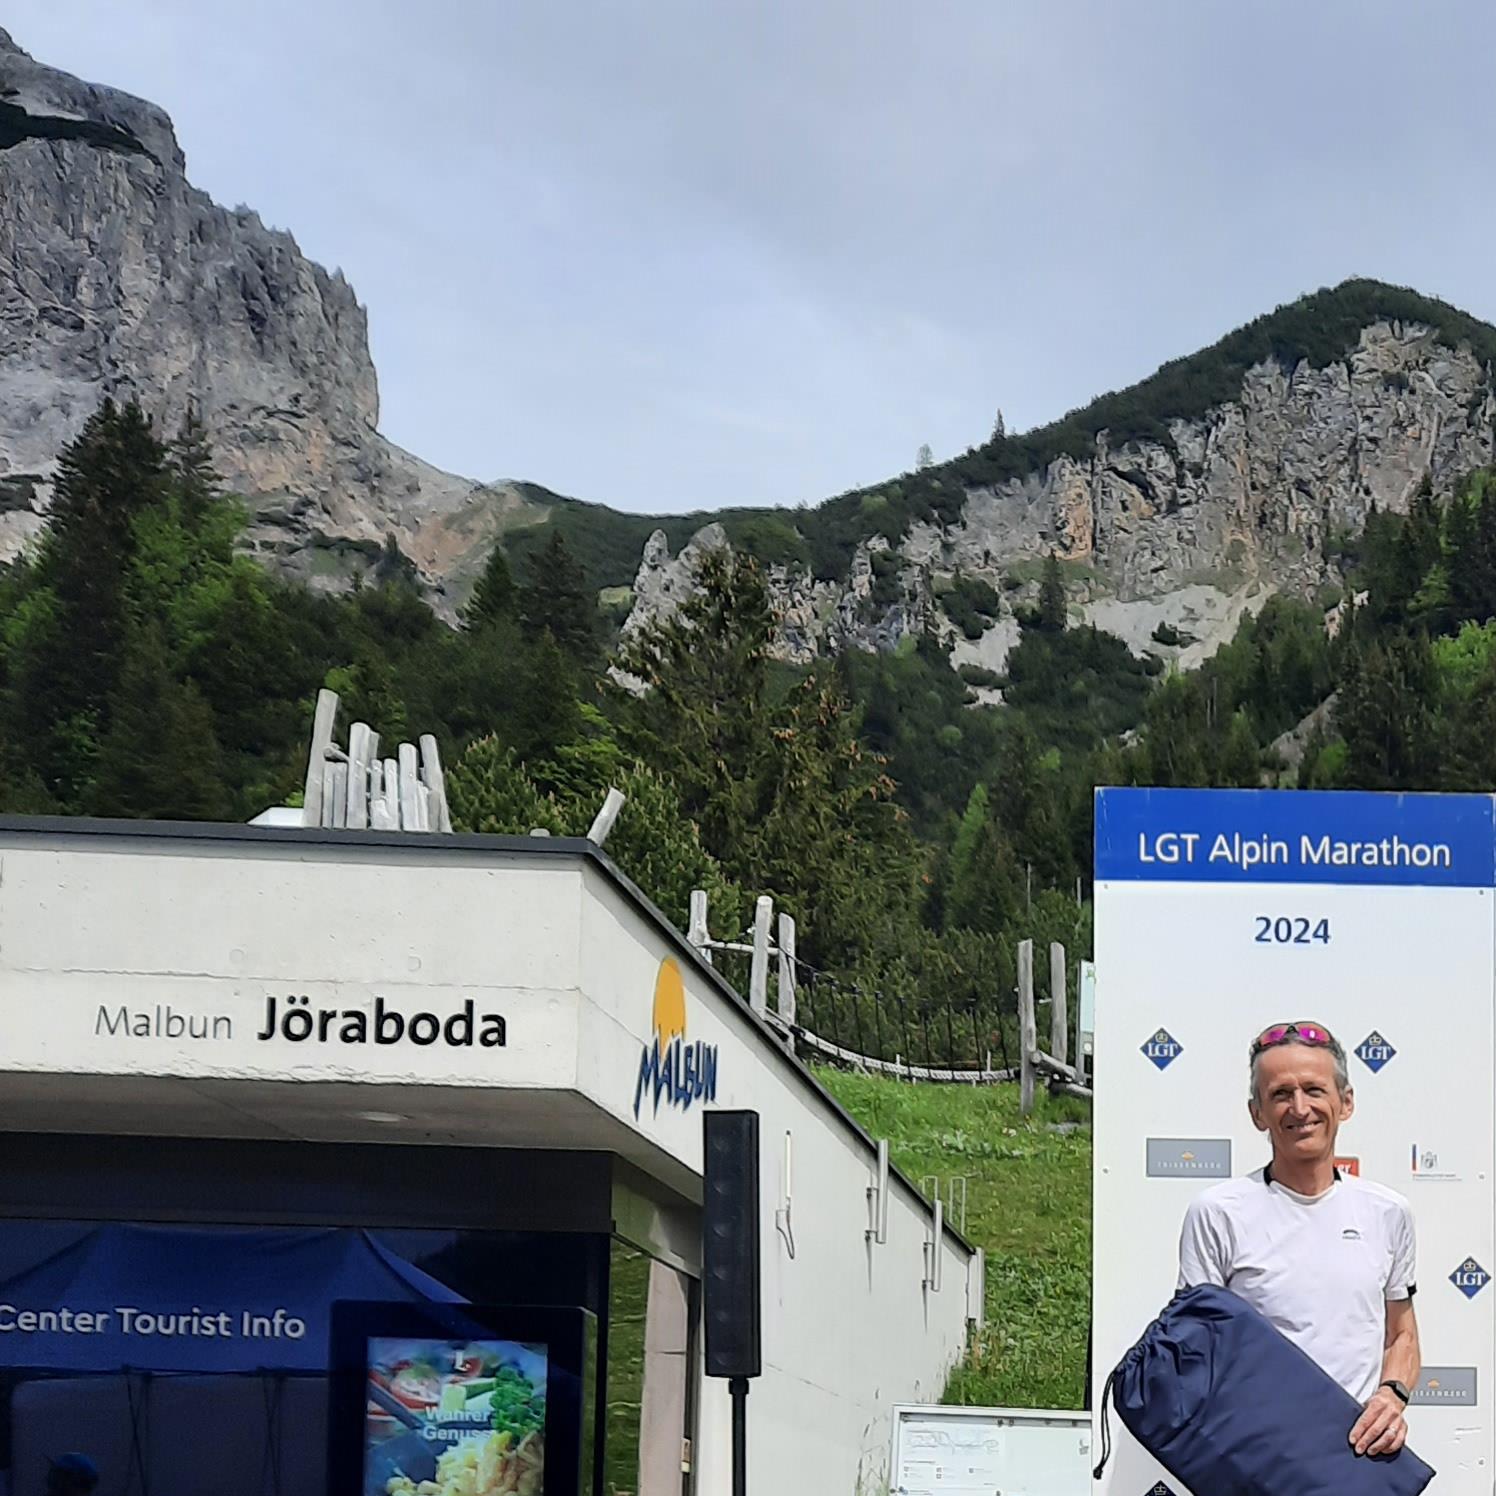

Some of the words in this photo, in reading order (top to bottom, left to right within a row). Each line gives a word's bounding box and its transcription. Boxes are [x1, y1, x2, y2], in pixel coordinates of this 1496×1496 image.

[1139, 832, 1199, 863] LGT
[1208, 831, 1289, 871] Alpin
[1300, 835, 1451, 867] Marathon
[1255, 916, 1331, 944] 2024
[95, 1005, 232, 1040] Malbun
[257, 996, 507, 1047] Jöraboda
[1147, 1042, 1178, 1057] LGT
[1361, 1045, 1392, 1060] LGT
[633, 1036, 718, 1122] MALBUN
[1456, 1271, 1486, 1286] LGT
[0, 1304, 110, 1333] Center
[115, 1307, 232, 1336] Tourist
[242, 1308, 305, 1338] Info
[425, 1405, 489, 1421] Wahrer
[423, 1425, 493, 1440] Genuss
